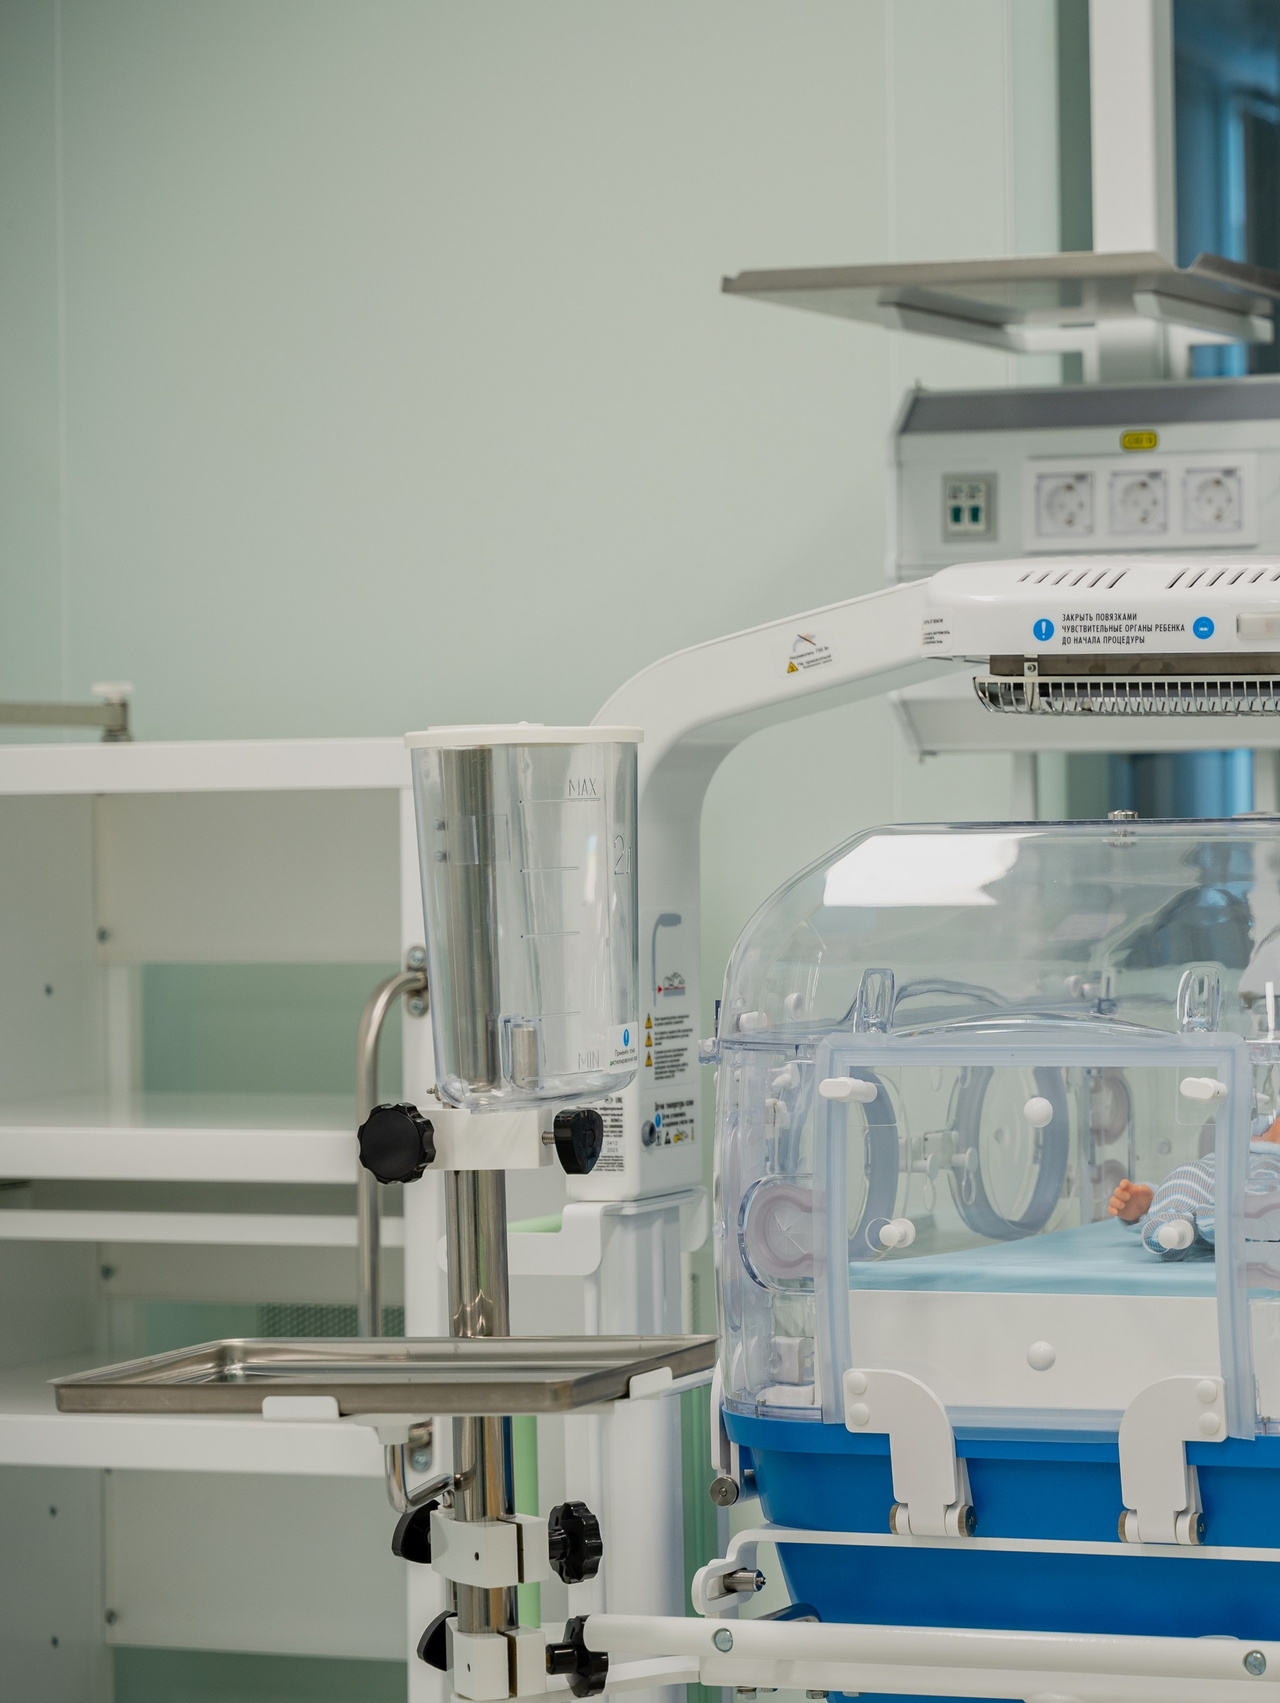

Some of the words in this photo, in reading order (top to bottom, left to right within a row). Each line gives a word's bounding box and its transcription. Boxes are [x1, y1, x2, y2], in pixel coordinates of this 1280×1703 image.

[1062, 613, 1093, 622] ЗАКРЫТЬ
[1095, 613, 1137, 622] ПОВЯЗКАМИ
[1062, 624, 1123, 633] ЧУВСТВИТЕЛЬНЫЕ
[1124, 624, 1153, 633] ОРГАНЫ
[1154, 624, 1185, 632] РЕБЕНКА
[1062, 636, 1072, 645] ДО
[1073, 636, 1101, 644] НАЧАЛА
[1103, 636, 1145, 645] ПРОЦЕДУРЫ
[568, 778, 597, 796] MAX
[578, 1050, 600, 1070] MIN
